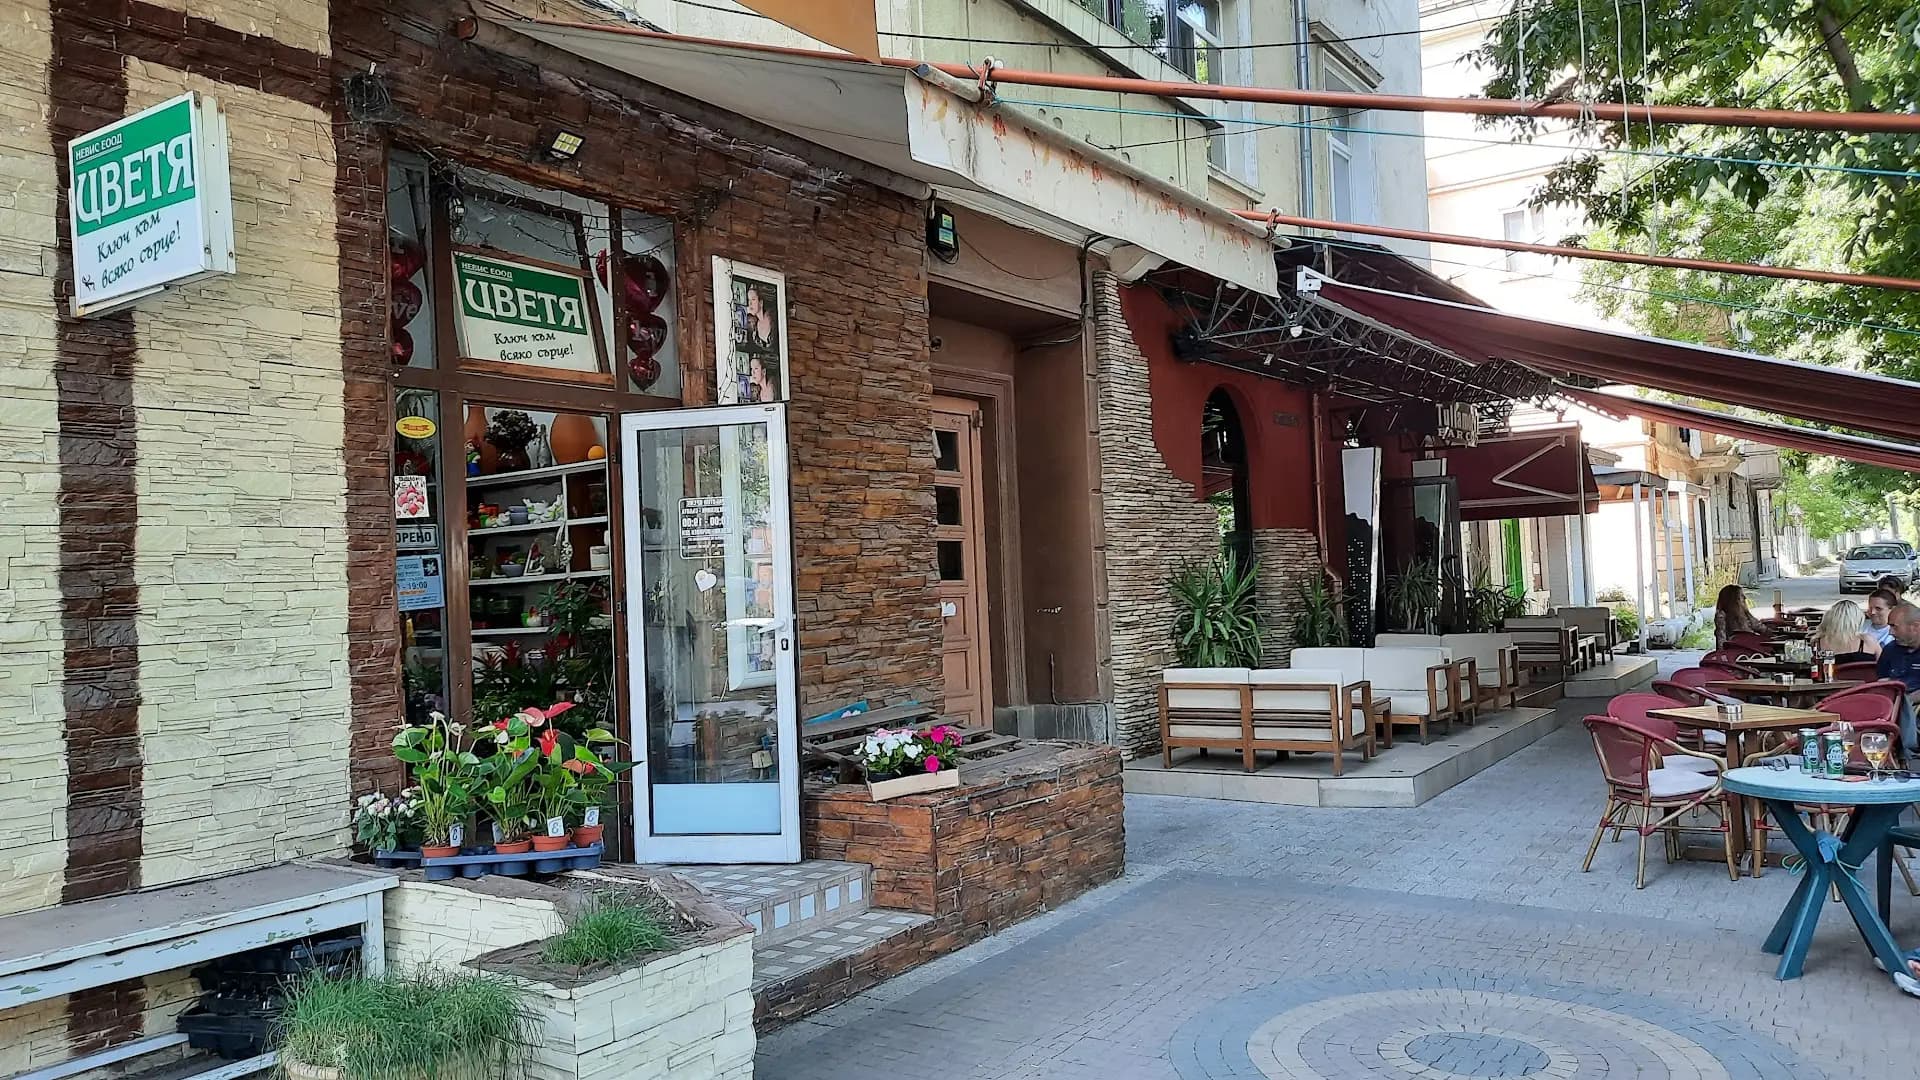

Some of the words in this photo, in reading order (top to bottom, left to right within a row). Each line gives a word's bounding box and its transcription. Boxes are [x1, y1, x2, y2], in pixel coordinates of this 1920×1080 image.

[75, 142, 100, 161] НЕВИС
[101, 132, 123, 151] ЕООД
[76, 133, 195, 224] ЦВЕТЯ
[97, 232, 130, 263] Ключ
[135, 211, 161, 235] към
[101, 257, 134, 288] всяко
[139, 220, 181, 265] сърце!
[461, 262, 489, 274] НЕВИС
[490, 268, 513, 279] ЕООД
[465, 278, 583, 329] ЦВЕТЯ
[494, 333, 527, 345] Ключ
[532, 332, 556, 341] към
[500, 349, 532, 361] всяко
[537, 344, 574, 360] сърце!
